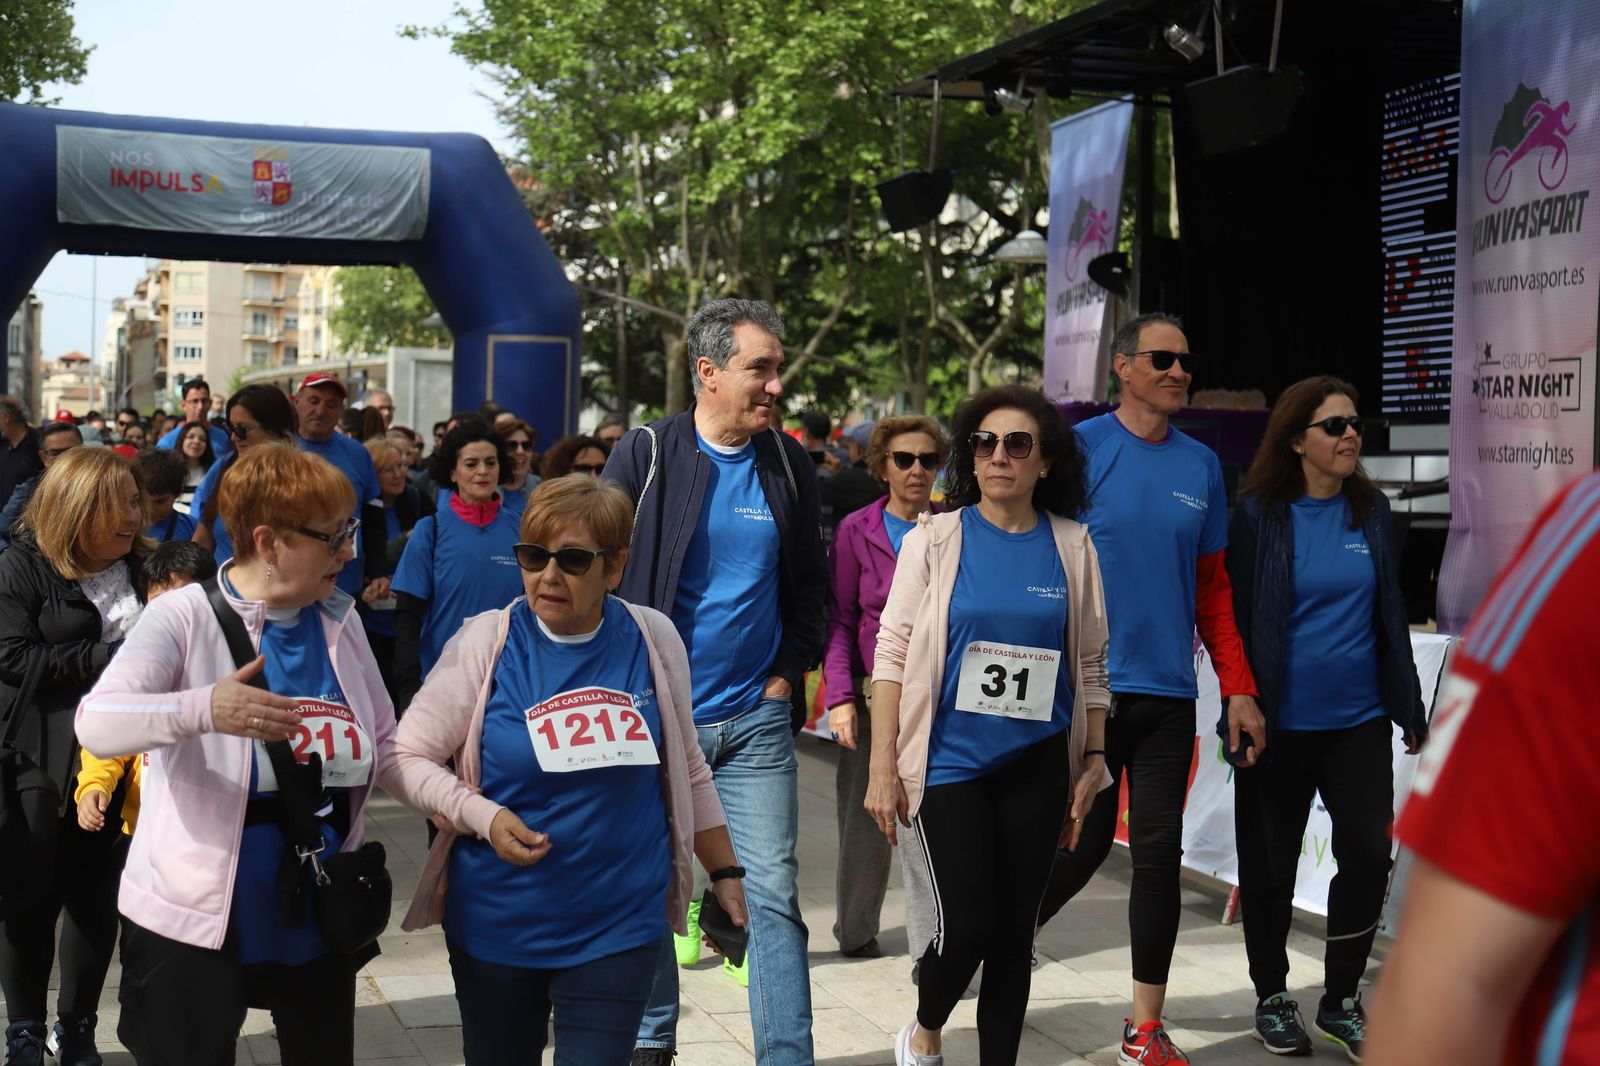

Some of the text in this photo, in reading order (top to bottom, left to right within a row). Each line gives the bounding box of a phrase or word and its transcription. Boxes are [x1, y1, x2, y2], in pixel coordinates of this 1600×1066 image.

[110, 150, 154, 166] NOS
[109, 167, 224, 195] IMPULSA
[1472, 190, 1590, 257] RUNVASPORT
[1472, 267, 1585, 296] www.runvasport.es
[1502, 352, 1547, 370] GRUPO
[1481, 372, 1575, 399] STAR NIGHT
[1487, 402, 1559, 420] VALLADOLID
[1478, 442, 1574, 470] www.starnight.es
[968, 644, 982, 653] DÍA
[983, 647, 993, 655] DE
[994, 649, 1027, 660] CASTILLA
[1034, 653, 1055, 663] LEÓN
[980, 663, 1030, 701] 31
[289, 704, 327, 713] ASTILLA
[531, 706, 546, 718] DÍA
[548, 700, 560, 710] DE
[562, 692, 604, 706] CASTILLA
[603, 692, 609, 700] Y
[289, 722, 361, 763] 211
[537, 708, 649, 750] 1212
